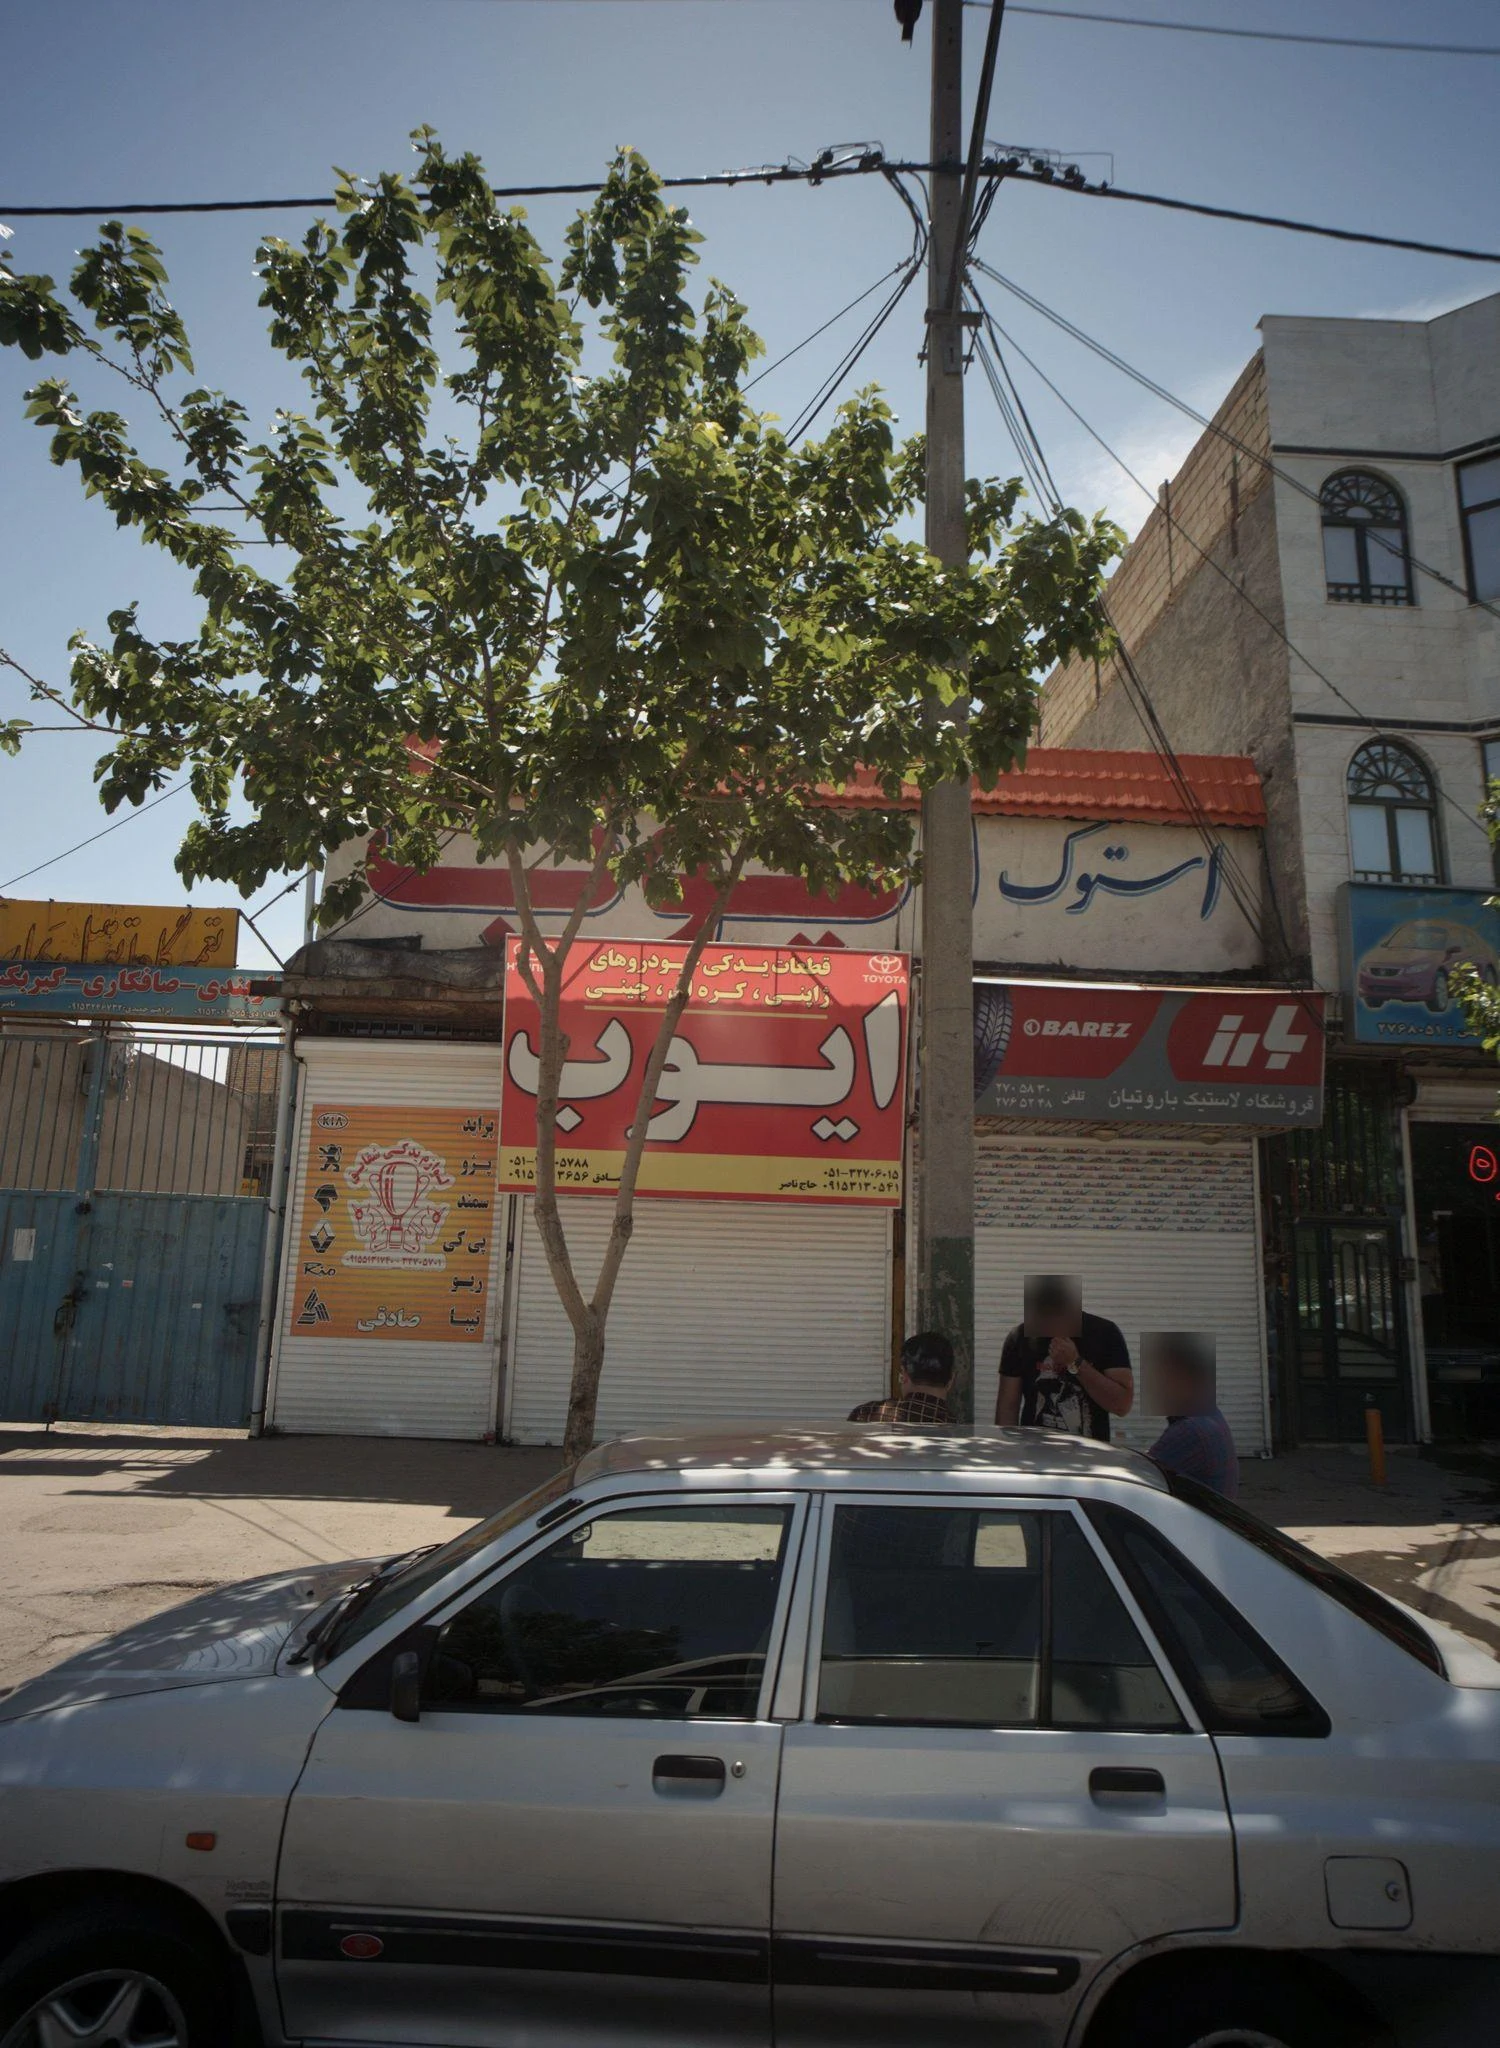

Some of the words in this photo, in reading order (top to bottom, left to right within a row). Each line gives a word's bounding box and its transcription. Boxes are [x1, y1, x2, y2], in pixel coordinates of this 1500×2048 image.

[589, 948, 701, 975] ودروهای
[702, 953, 769, 977] یدکی
[772, 956, 831, 976] قطعات
[82, 966, 180, 998] صافکاری
[862, 973, 908, 985] TOYOTA
[585, 978, 650, 1003] چینی
[697, 982, 748, 1004] کره
[765, 985, 831, 1009] ژاپنی
[1041, 1020, 1133, 1038] BAREZ
[1062, 1088, 1086, 1104] تلفن
[1183, 1091, 1240, 1111] لاستیک
[1245, 1094, 1314, 1115] فروشگاه
[321, 1115, 345, 1127] KIA
[457, 1193, 490, 1209] سمند
[357, 1305, 421, 1332] صادقی
